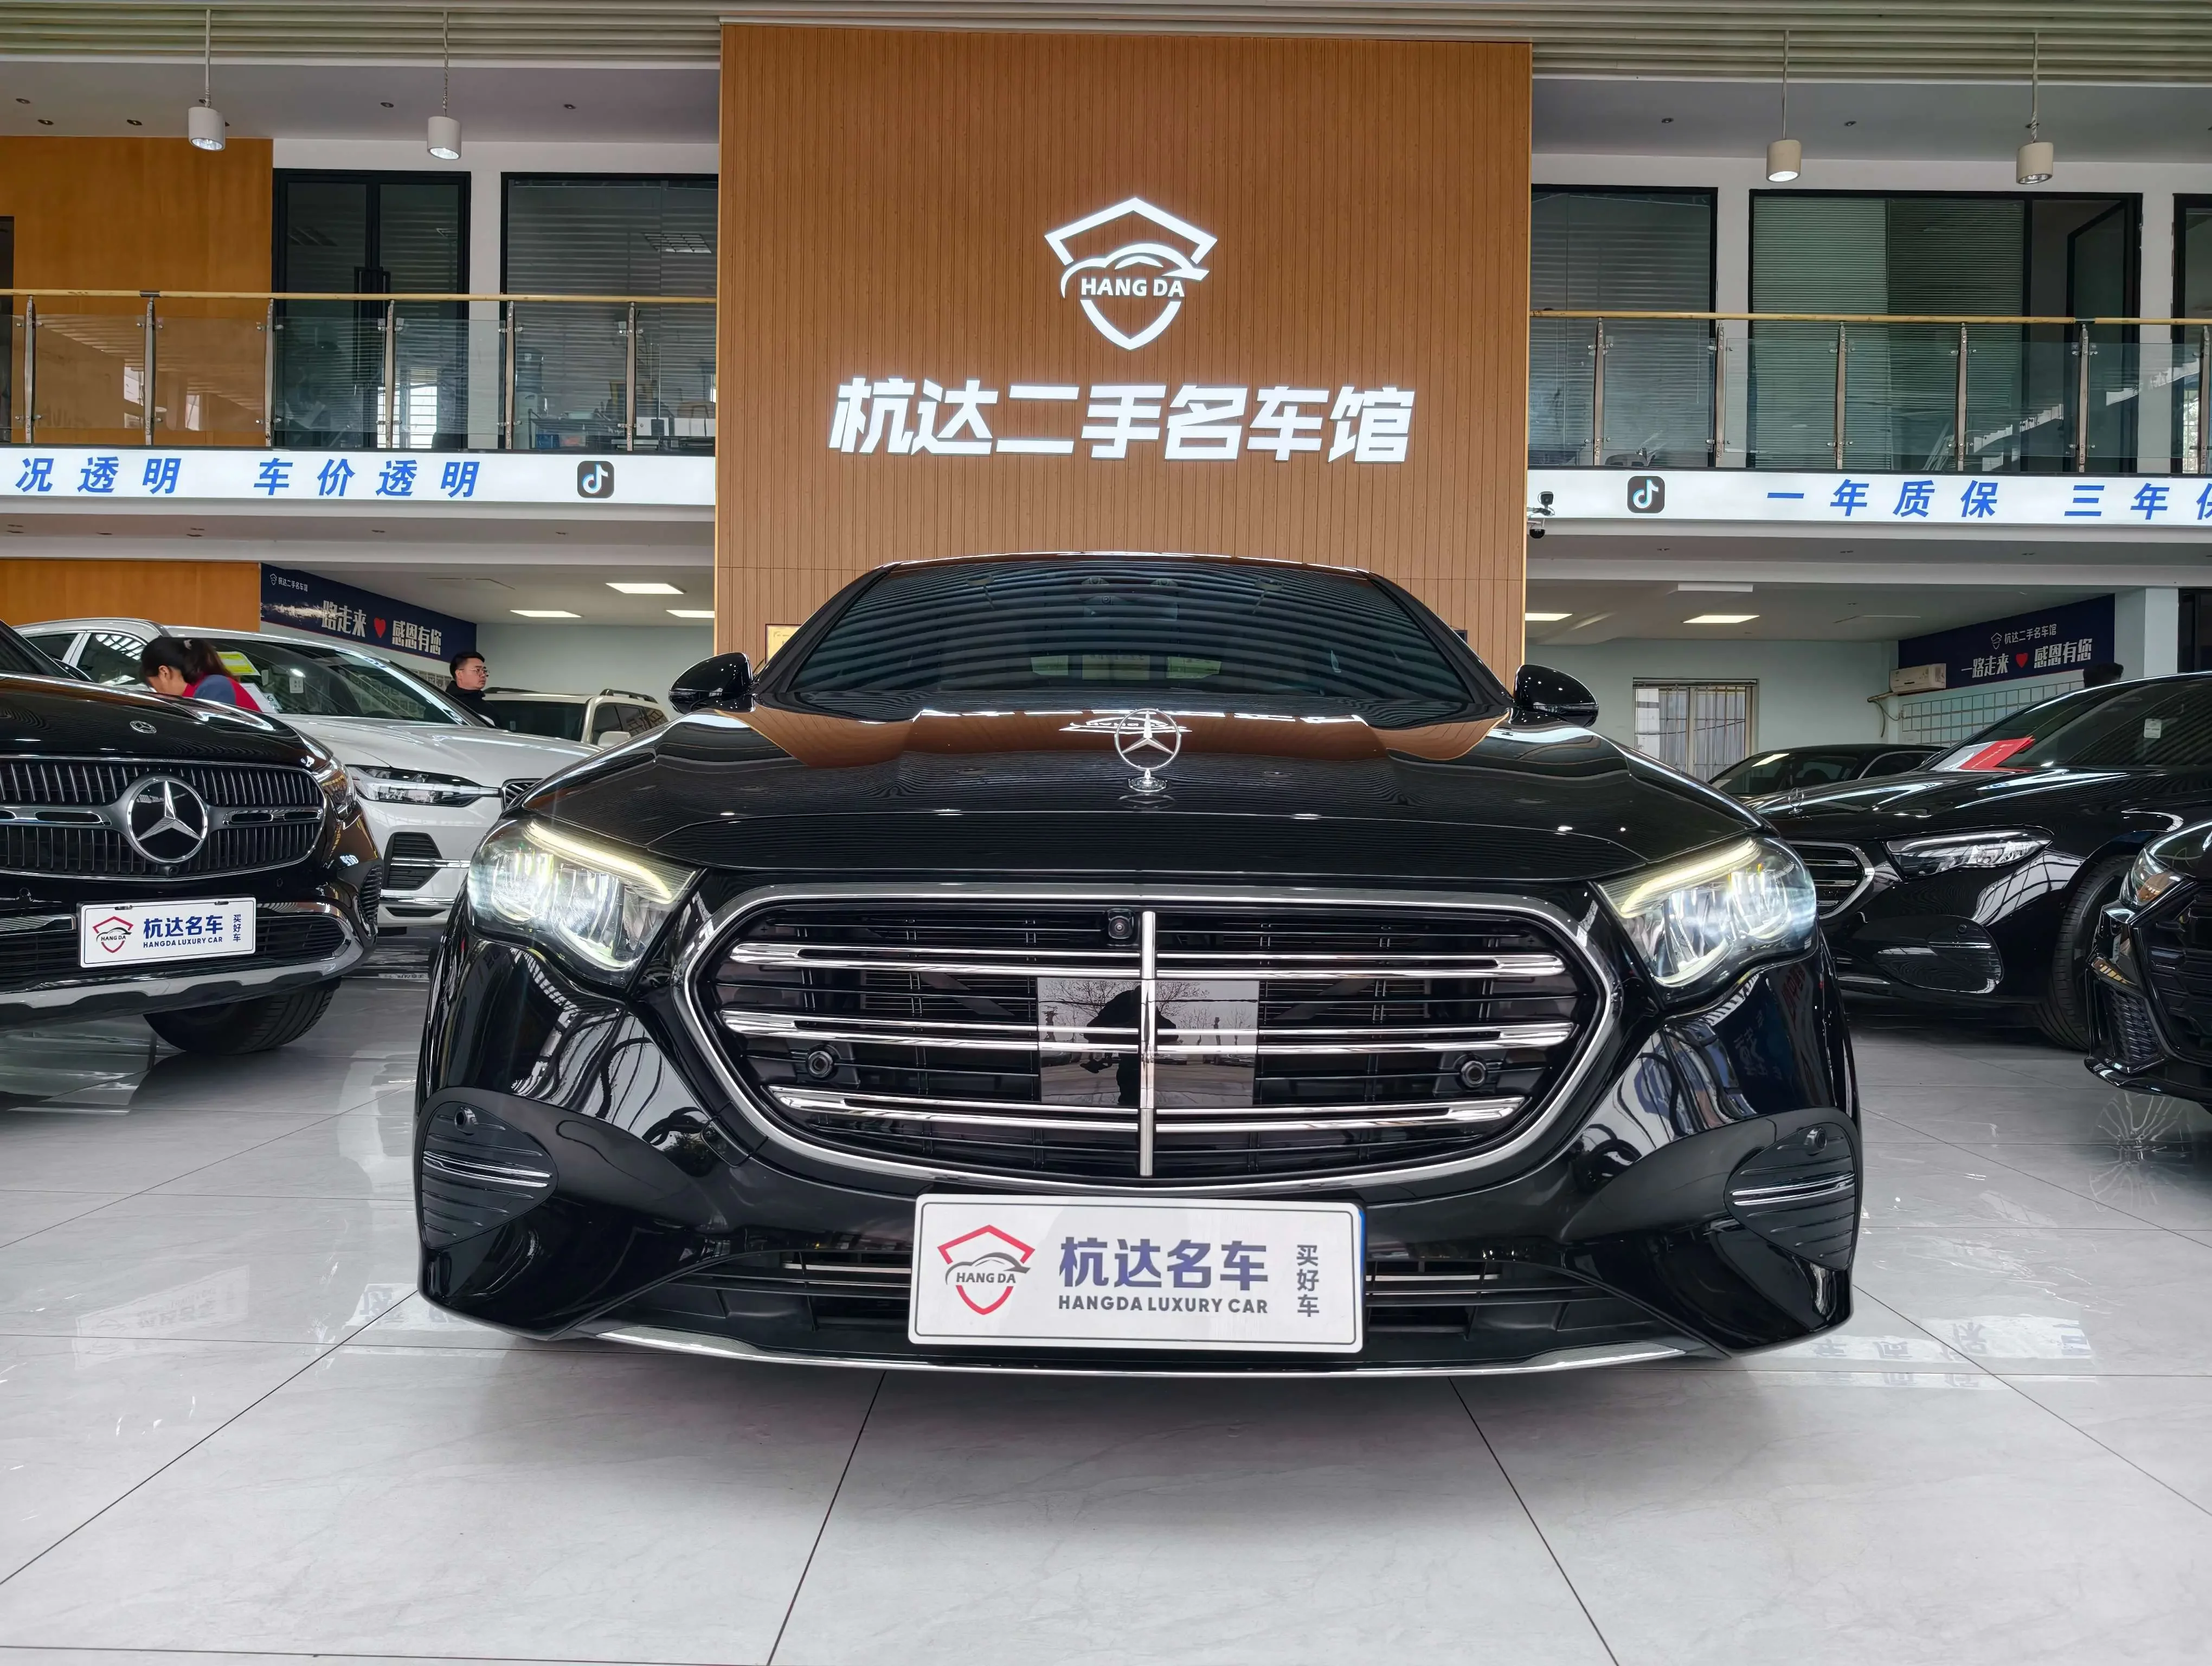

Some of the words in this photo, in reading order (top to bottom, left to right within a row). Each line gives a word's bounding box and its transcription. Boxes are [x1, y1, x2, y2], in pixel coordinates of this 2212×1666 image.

[1081, 278, 1147, 297] HANG
[1153, 278, 1185, 298] DA
[828, 376, 1415, 464] 杭达二手名车馆
[15, 456, 182, 495] 况透明
[254, 457, 480, 498] 车价透明
[1767, 478, 1999, 518] 一年质保
[391, 619, 442, 656] 感恩有您
[1960, 653, 2010, 678] 一路走来
[2034, 638, 2093, 669] 感恩有您
[143, 915, 223, 939] 杭达名车
[143, 940, 176, 948] HANGDA
[233, 914, 241, 942] 买好车
[956, 1272, 994, 1283] HANG
[997, 1273, 1016, 1284] DA
[1058, 1236, 1269, 1291] 杭达名车
[1296, 1244, 1320, 1317] 买好车
[1058, 1295, 1142, 1311] HANGDA
[1147, 1297, 1224, 1313] LUXURY
[1228, 1299, 1268, 1314] CAR
